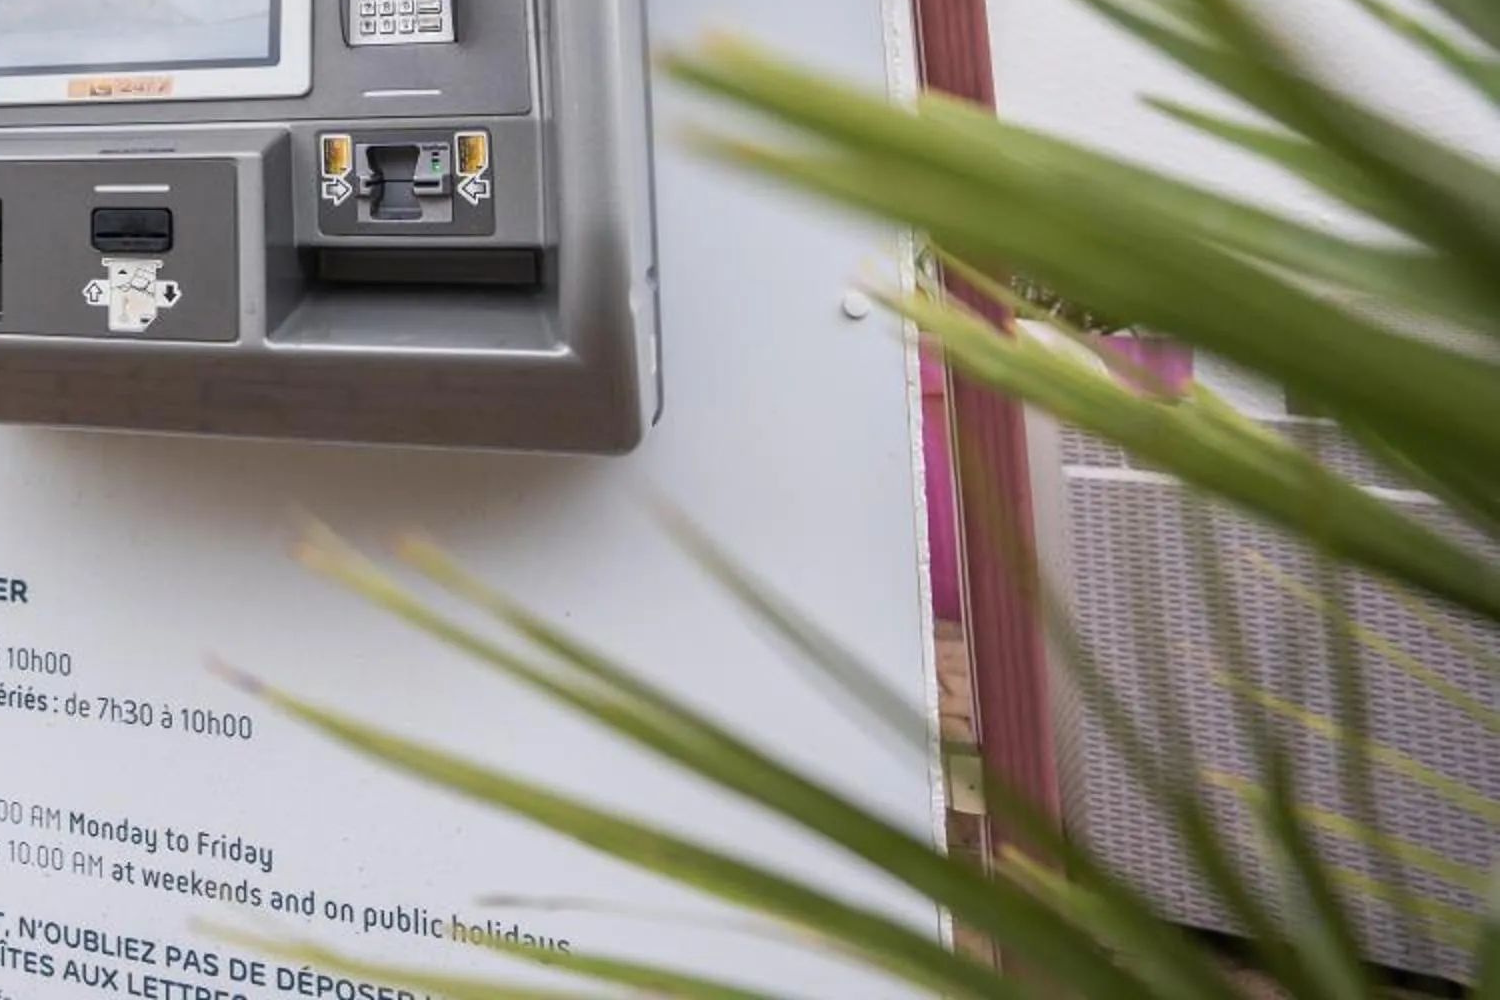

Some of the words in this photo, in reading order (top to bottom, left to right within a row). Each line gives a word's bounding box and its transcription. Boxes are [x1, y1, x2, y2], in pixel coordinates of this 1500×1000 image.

[8, 647, 72, 676] 10h00
[64, 694, 91, 718] de
[97, 698, 153, 727] 7h30
[161, 705, 173, 729] à
[181, 708, 253, 740] 10h00
[31, 805, 62, 831] AM
[69, 812, 156, 853] Monday
[165, 829, 189, 852] to
[197, 832, 274, 872] Friday
[8, 840, 63, 870] 10.00
[72, 851, 103, 878] AM
[111, 861, 134, 884] at
[142, 868, 262, 907] weekends
[271, 891, 315, 915] and
[324, 901, 354, 923] on
[363, 904, 444, 939] public
[18, 916, 156, 964] N'OUBLIEZ
[166, 945, 219, 977] PAS
[230, 958, 266, 986] DE
[63, 959, 118, 992] AUX
[128, 972, 248, 1000] LETTR
